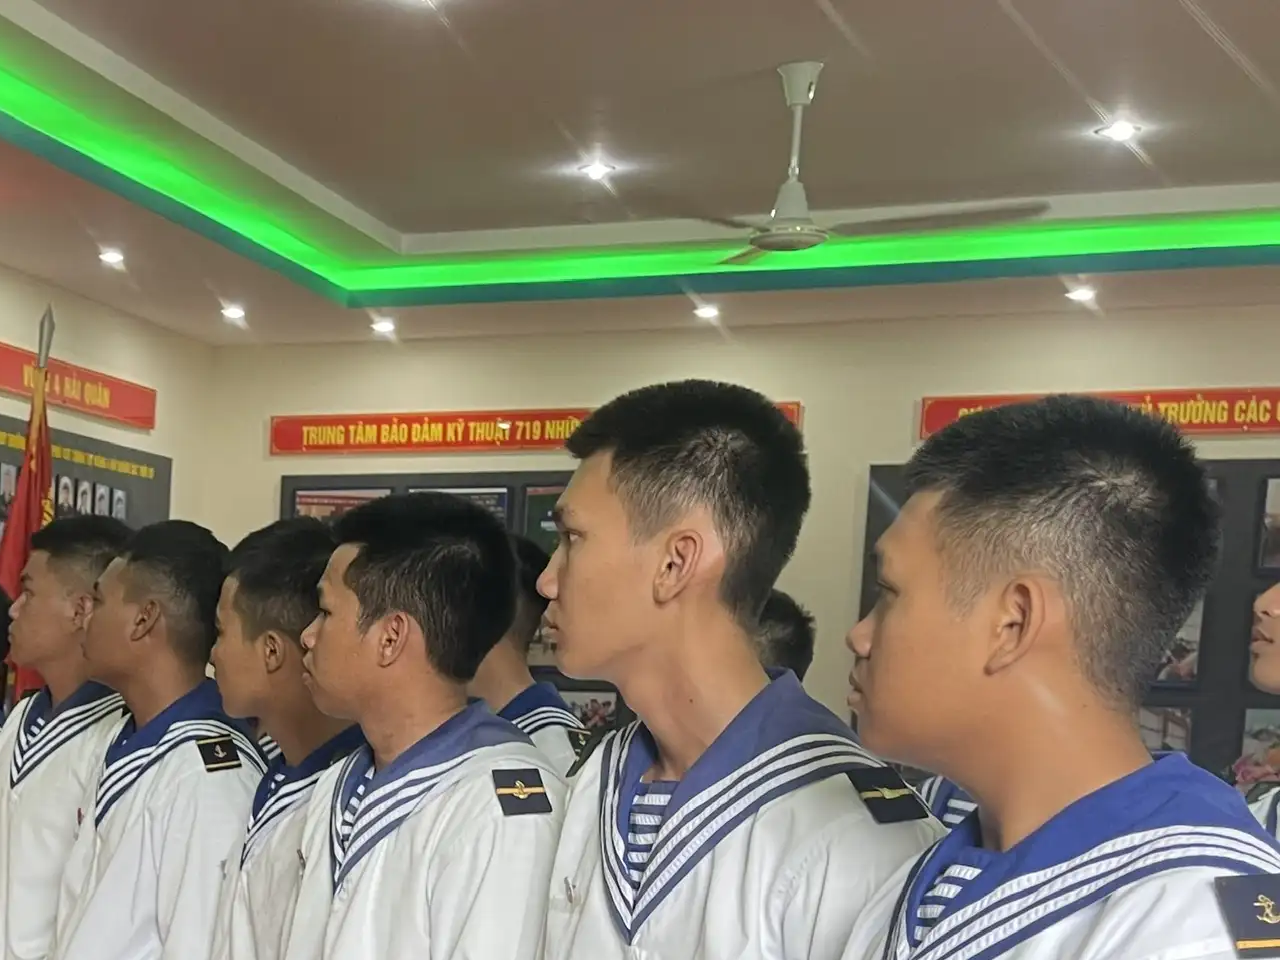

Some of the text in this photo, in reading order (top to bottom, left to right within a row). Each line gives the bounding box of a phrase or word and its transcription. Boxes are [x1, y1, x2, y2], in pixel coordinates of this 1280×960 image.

[1234, 395, 1271, 423] CÁC
[302, 425, 345, 445] TRUNG
[349, 421, 377, 445] TÂM
[381, 416, 409, 444] BẢO
[515, 420, 541, 440] 719
